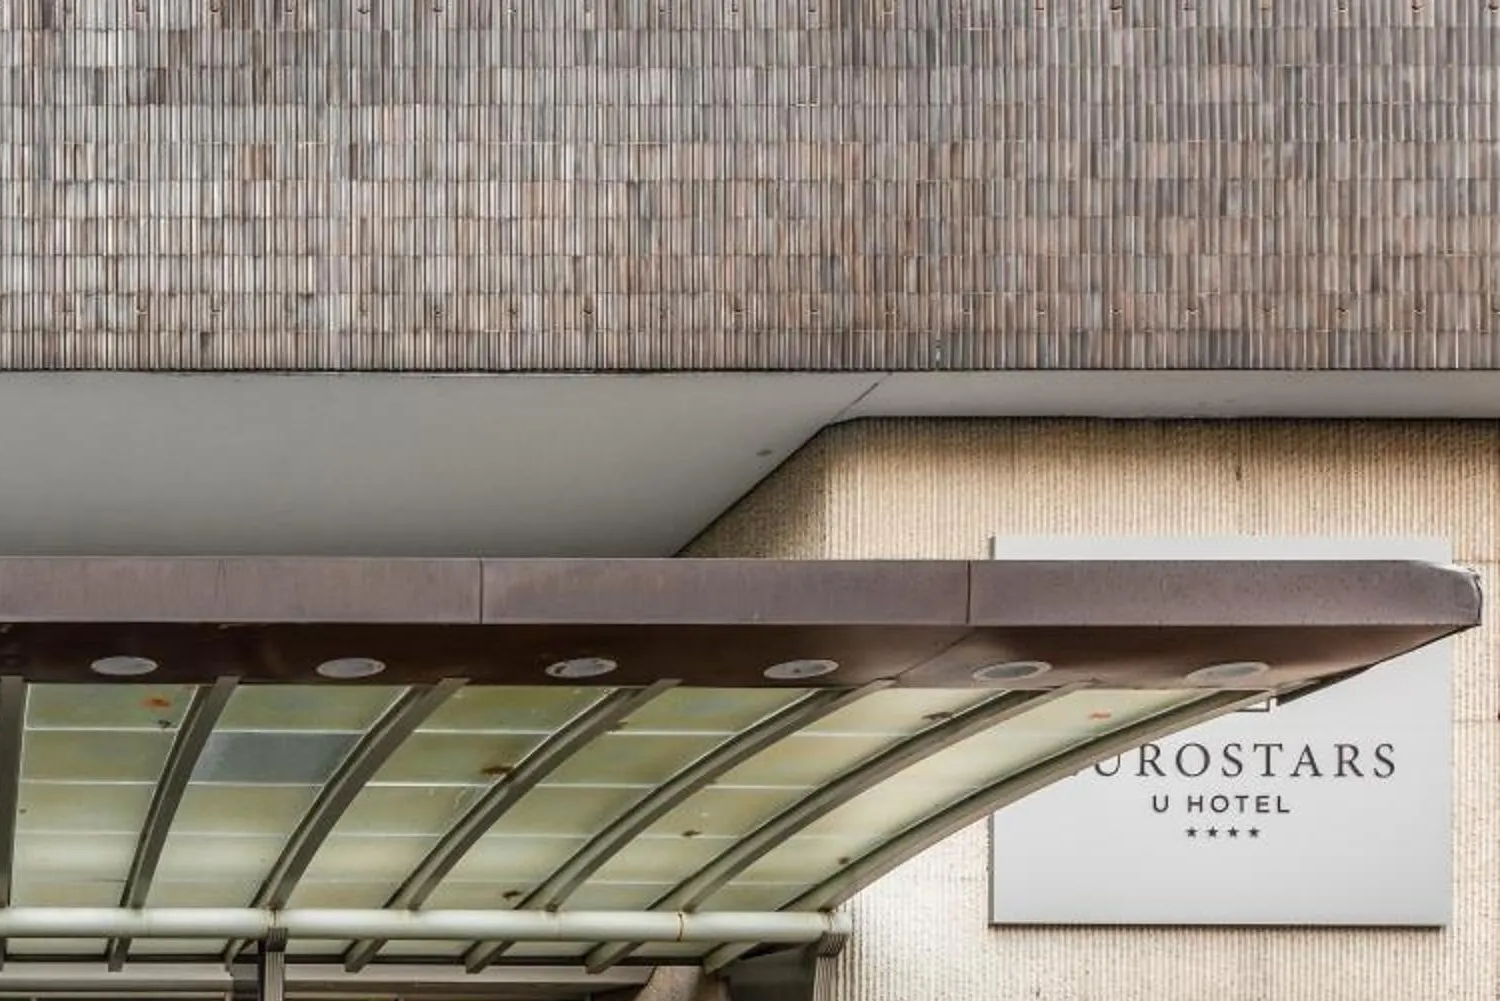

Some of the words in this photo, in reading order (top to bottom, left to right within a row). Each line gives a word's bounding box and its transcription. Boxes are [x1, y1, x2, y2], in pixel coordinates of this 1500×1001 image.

[1073, 743, 1395, 778] UROSTARS
[1152, 795, 1170, 813] U
[1187, 795, 1290, 813] HOTEL
